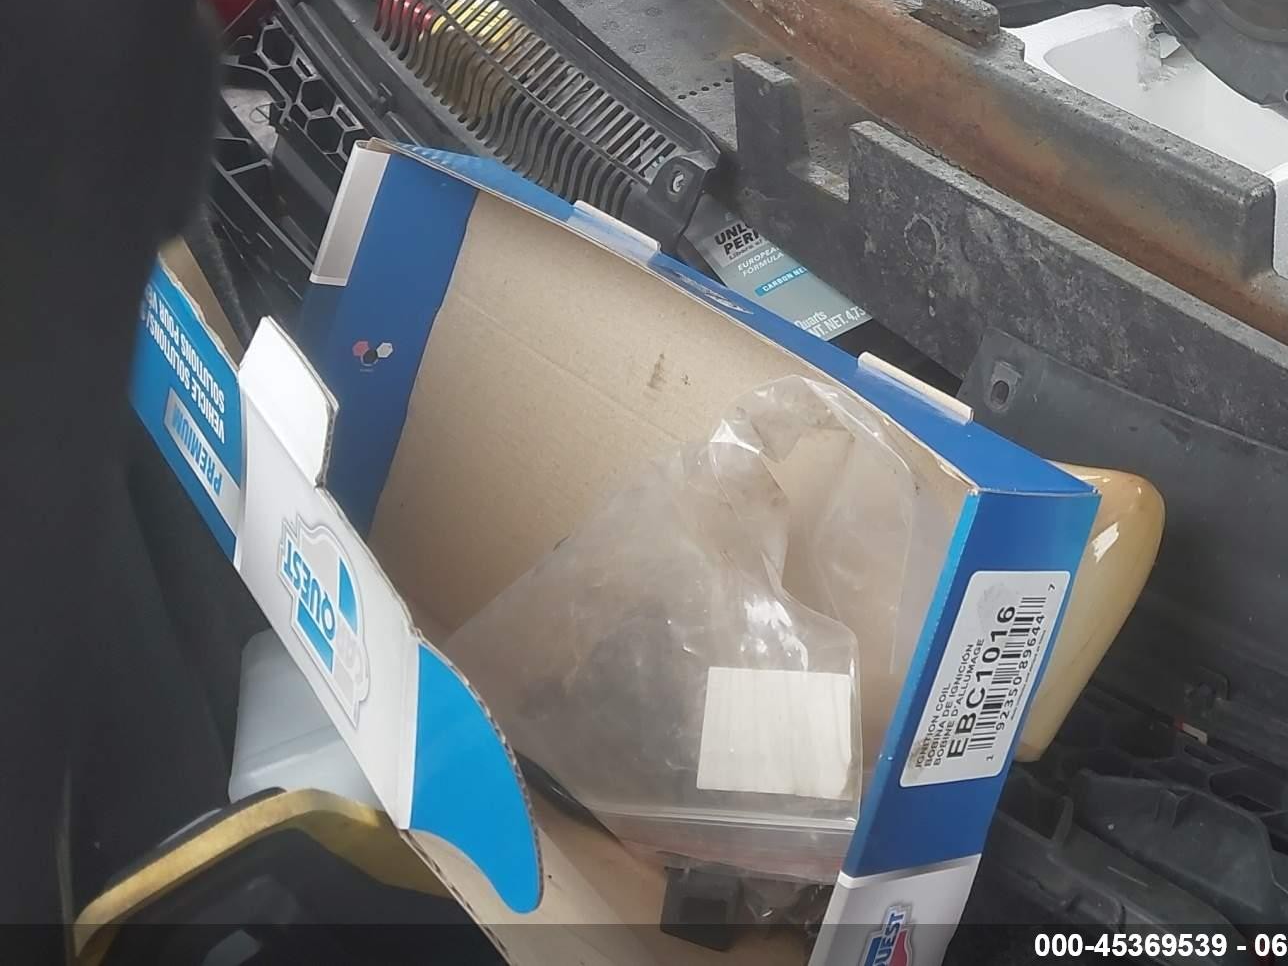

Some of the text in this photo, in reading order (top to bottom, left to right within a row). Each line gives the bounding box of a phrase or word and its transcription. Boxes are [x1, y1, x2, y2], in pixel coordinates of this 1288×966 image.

[742, 252, 785, 277] FORMULA
[762, 273, 794, 292] CARBON
[180, 333, 226, 413] SOLUTIONS
[191, 377, 226, 444] VEHICLE
[171, 403, 223, 497] PREMIUM
[284, 540, 336, 641] QUEST
[924, 643, 974, 767] BOBINA DE IGNICIÓN
[933, 638, 984, 766] BOBINE D'ALLUMAGE
[946, 605, 1017, 759] EBC1016
[995, 676, 1023, 731] 92350
[1018, 614, 1045, 669] 89644
[915, 683, 951, 768] IGNITION COIL
